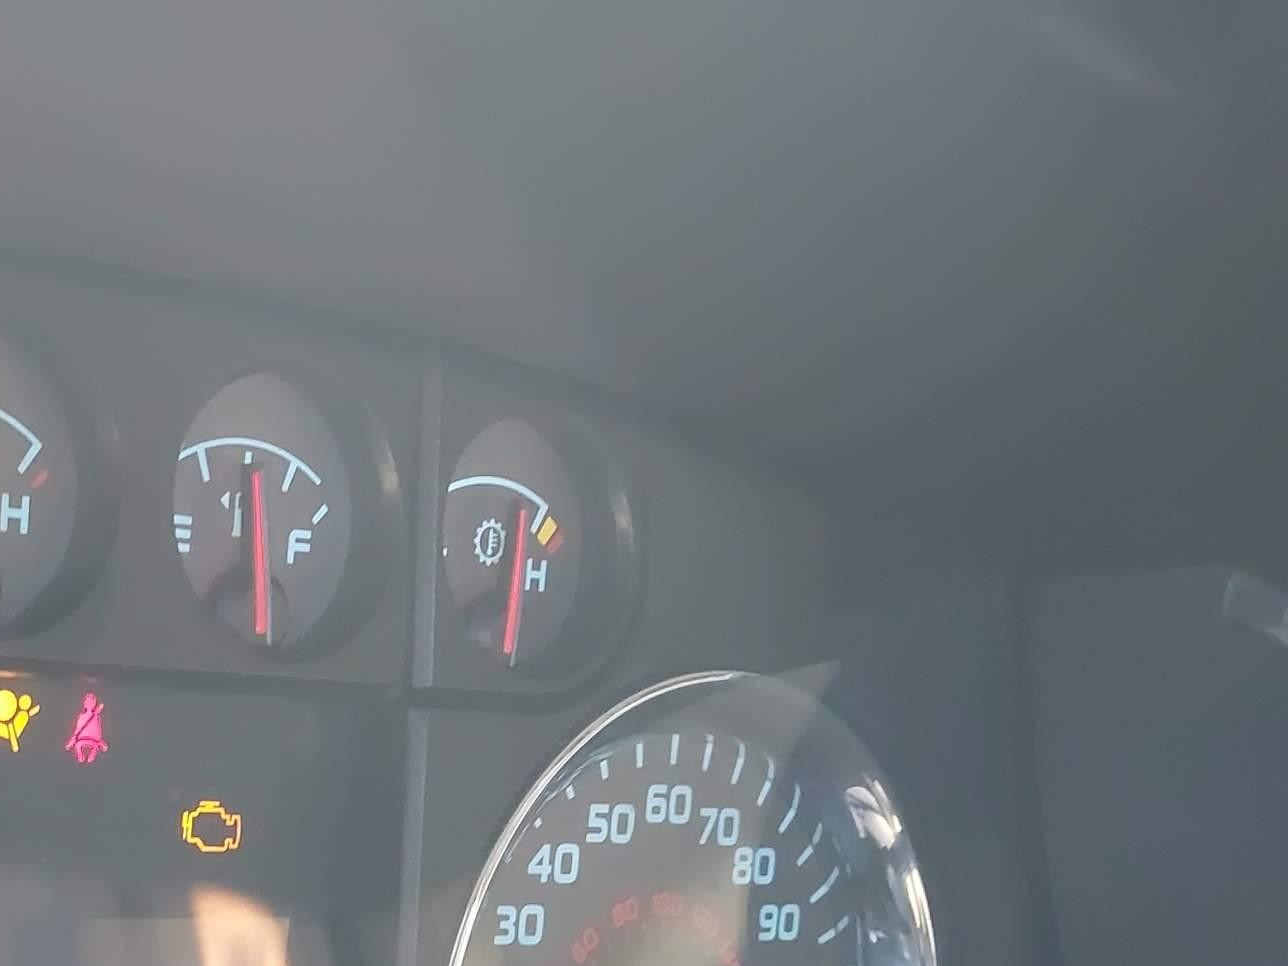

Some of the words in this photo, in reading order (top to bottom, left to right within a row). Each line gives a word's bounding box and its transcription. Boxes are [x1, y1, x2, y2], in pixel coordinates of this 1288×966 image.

[0, 492, 31, 535] H
[286, 528, 312, 564] F
[524, 558, 548, 592] H
[585, 803, 637, 845] 50
[645, 783, 693, 825] 60
[699, 807, 740, 847] 70
[527, 843, 580, 885] 40
[732, 847, 776, 886] 80
[493, 904, 545, 947] 30
[758, 903, 801, 943] 90
